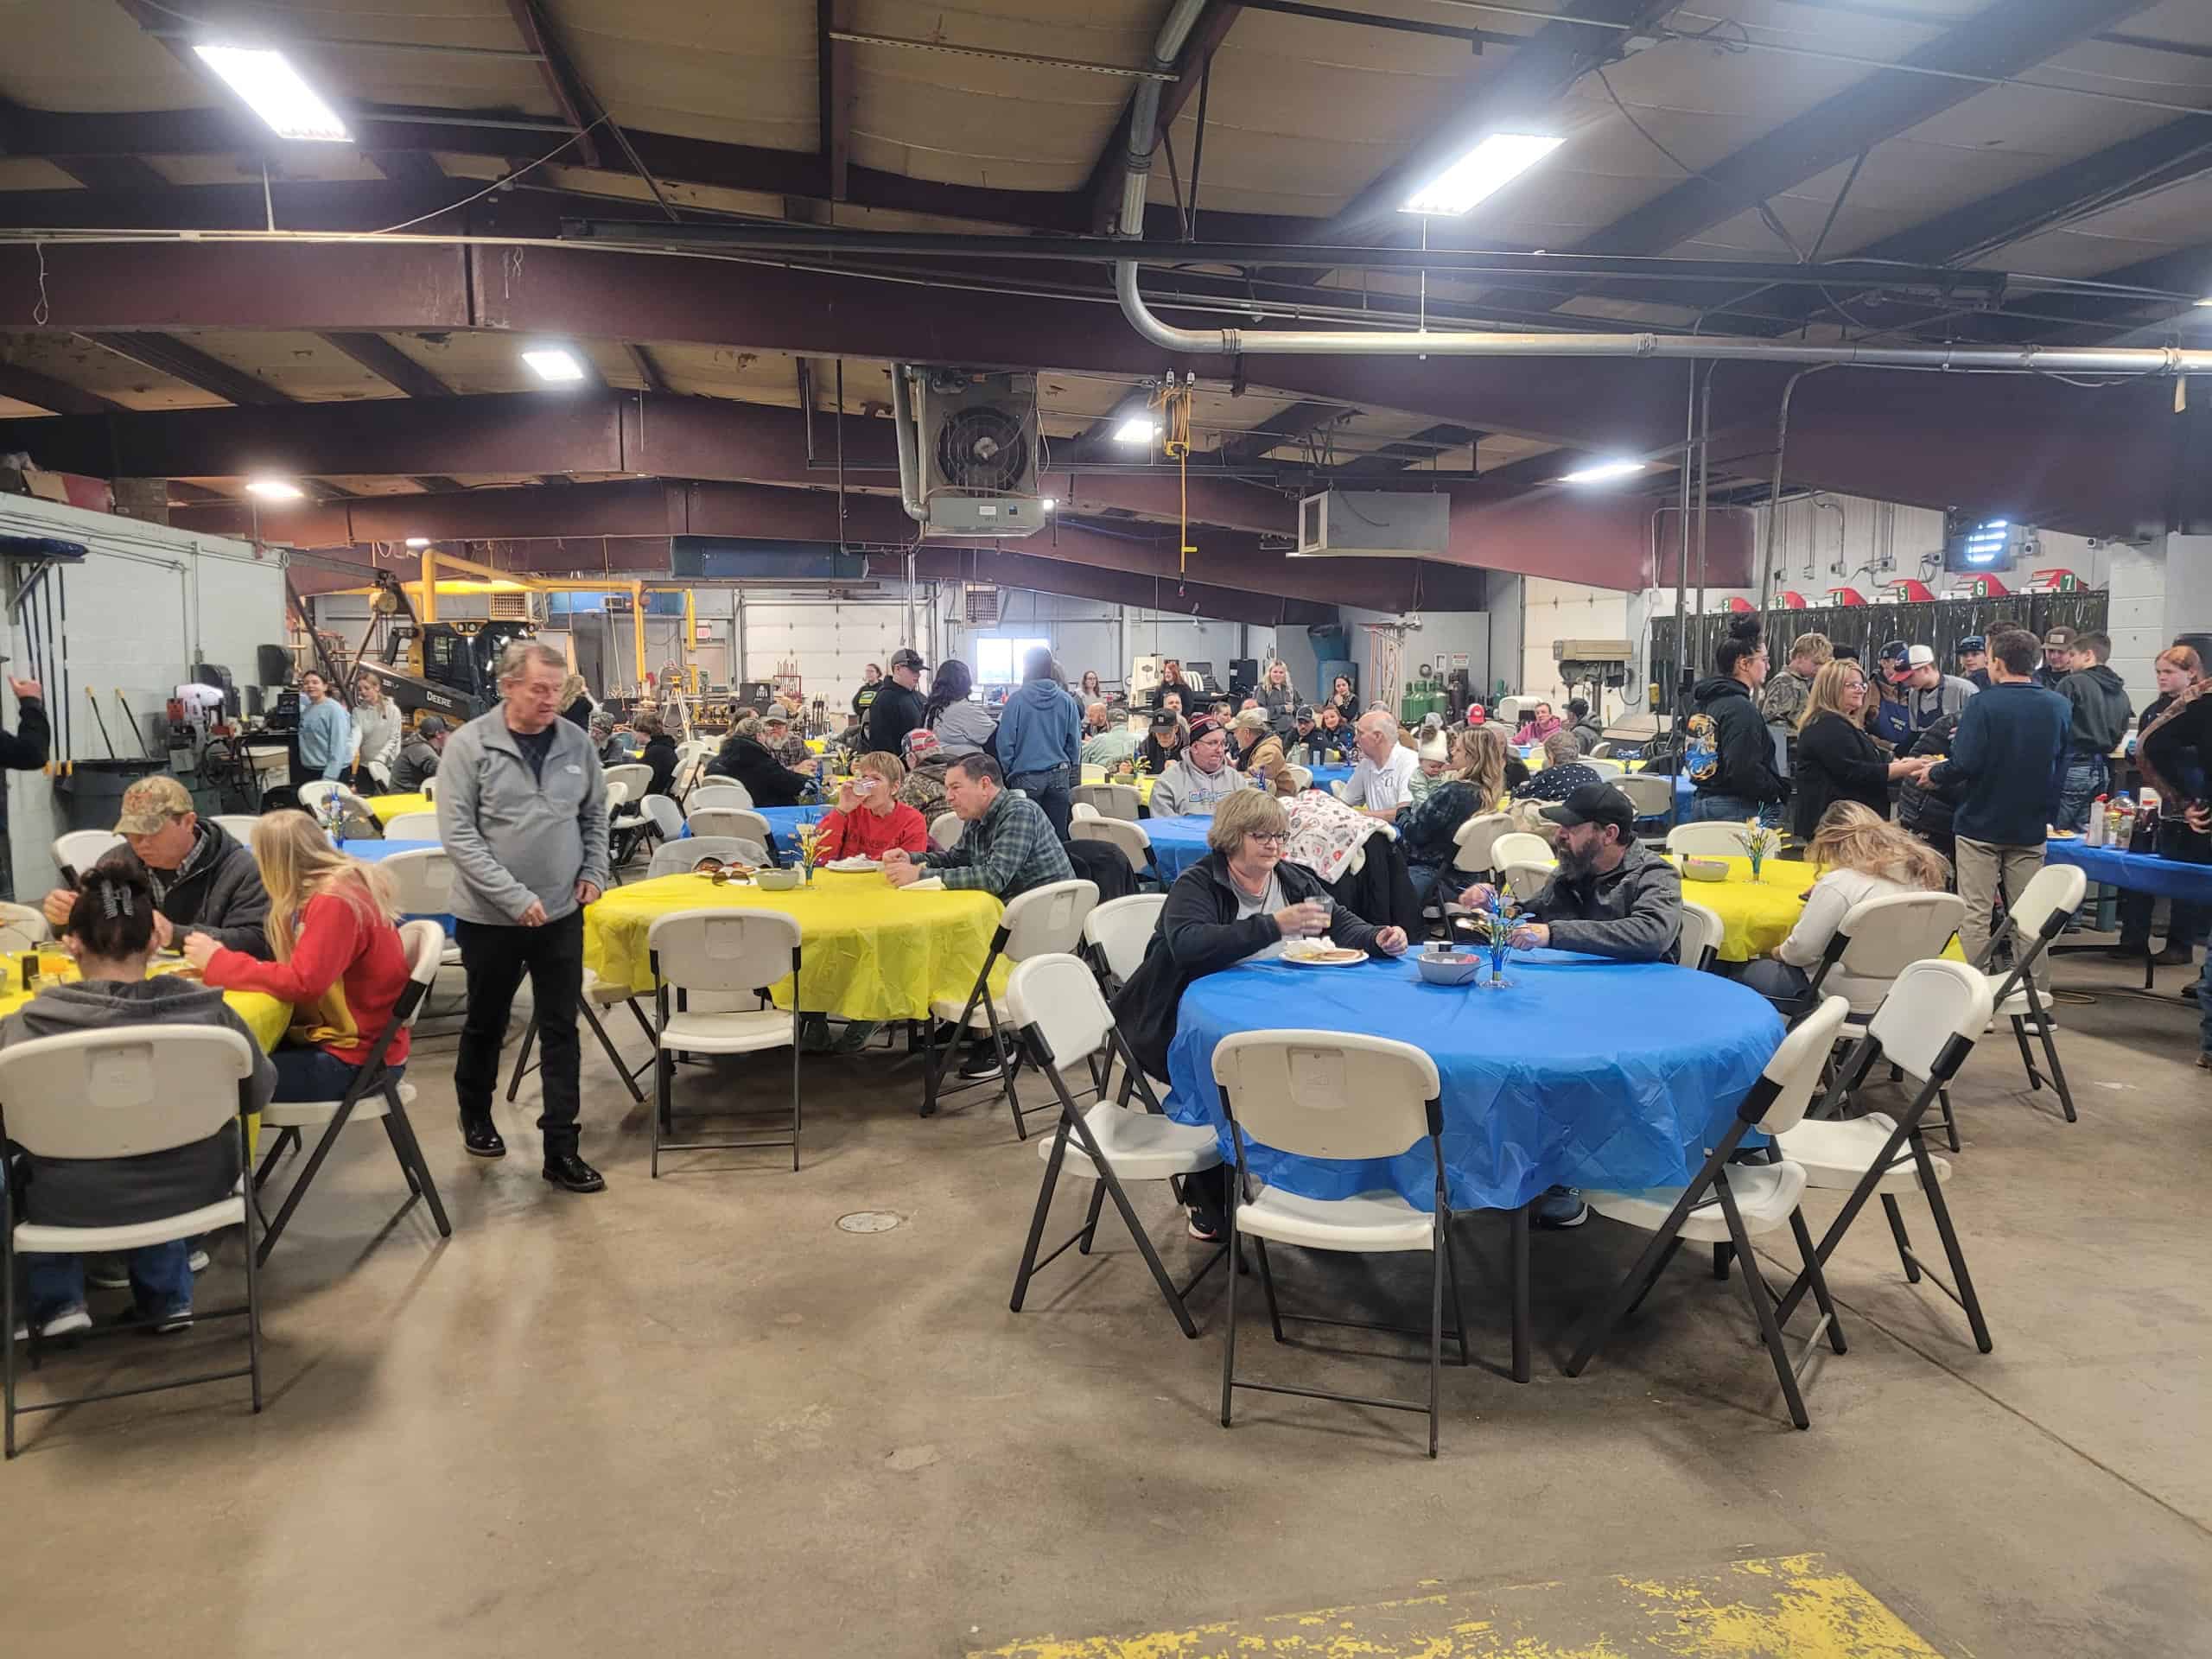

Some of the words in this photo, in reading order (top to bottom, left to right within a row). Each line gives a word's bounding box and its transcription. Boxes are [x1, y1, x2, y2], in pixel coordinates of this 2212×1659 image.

[1977, 581, 1984, 595] 6
[2065, 574, 2072, 590] 7
[1899, 587, 1906, 601] 5
[1724, 600, 1729, 611] 2
[1777, 596, 1783, 608] 3
[427, 690, 452, 708] DEERE
